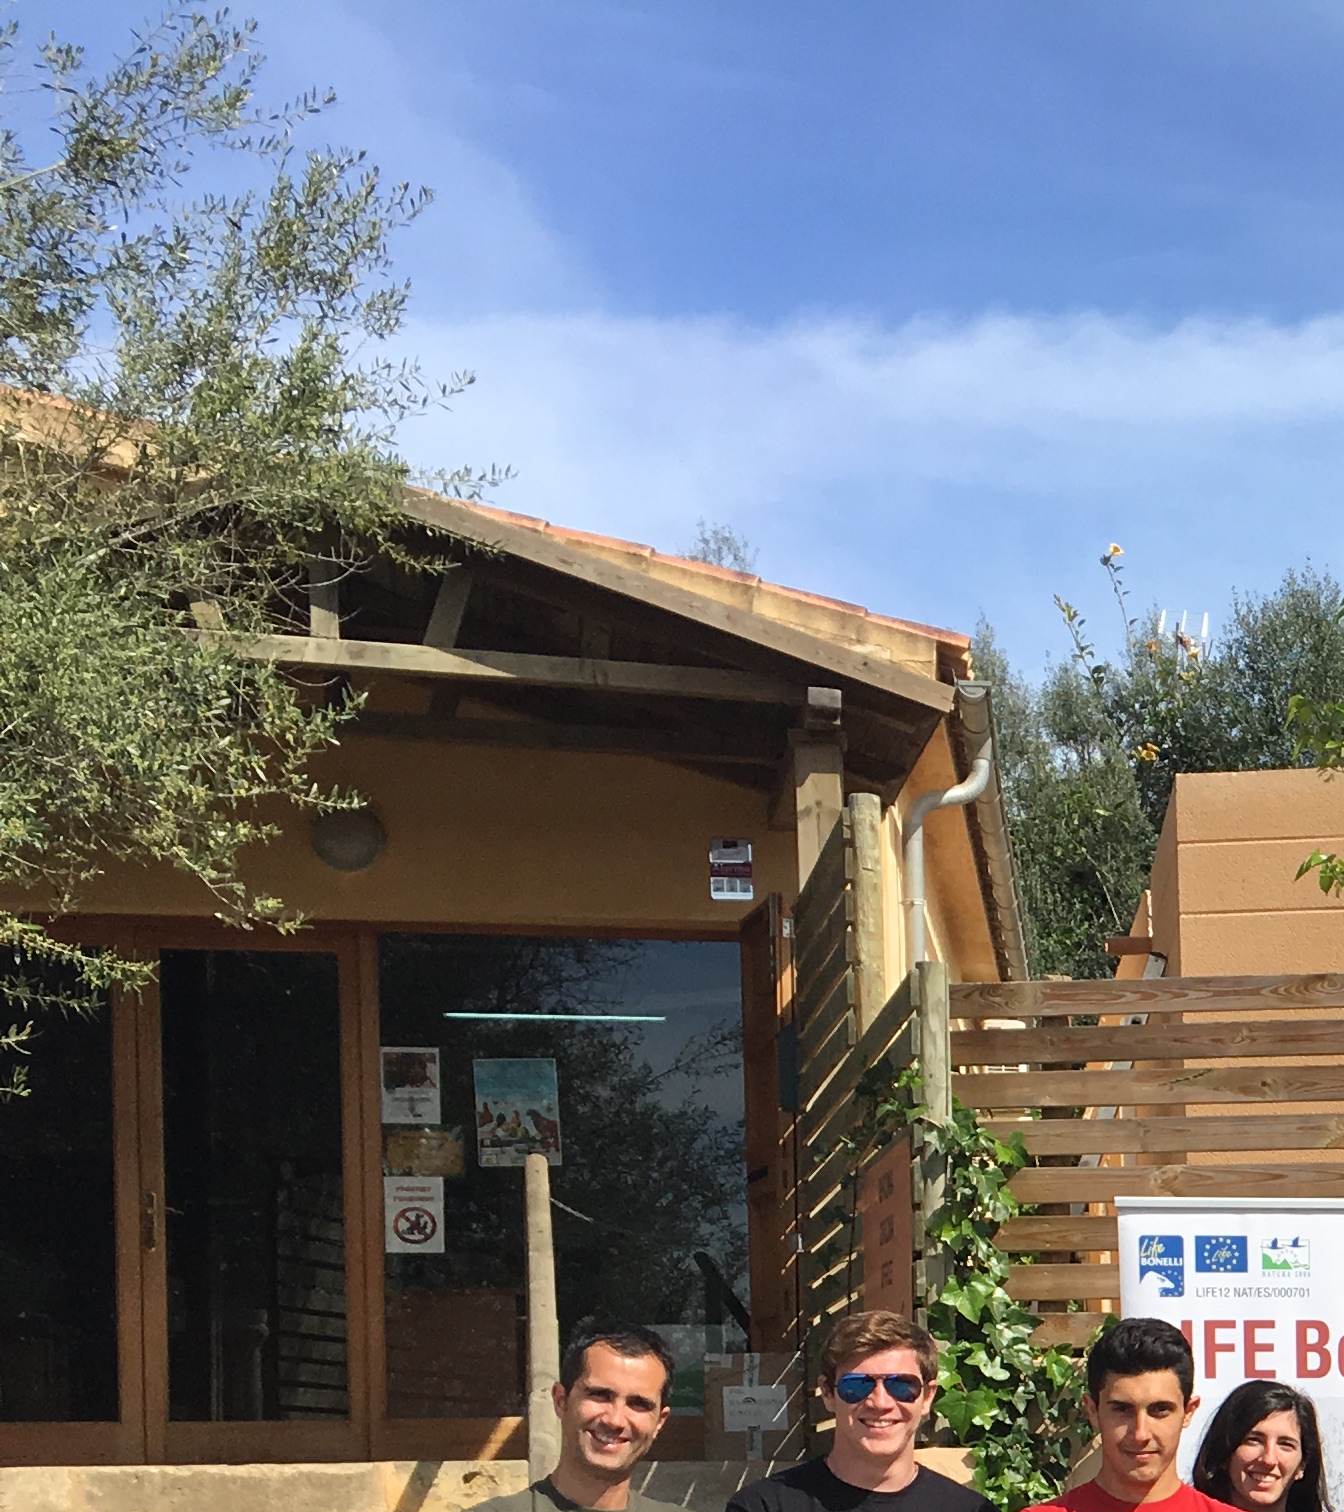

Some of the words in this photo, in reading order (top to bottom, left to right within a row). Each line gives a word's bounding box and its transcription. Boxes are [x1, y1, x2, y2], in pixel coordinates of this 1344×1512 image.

[1140, 1236, 1165, 1258] Life
[1141, 1257, 1183, 1266] BONELLI
[1196, 1287, 1230, 1298] LIFE12
[1234, 1287, 1310, 1298] NAT/ES/000701
